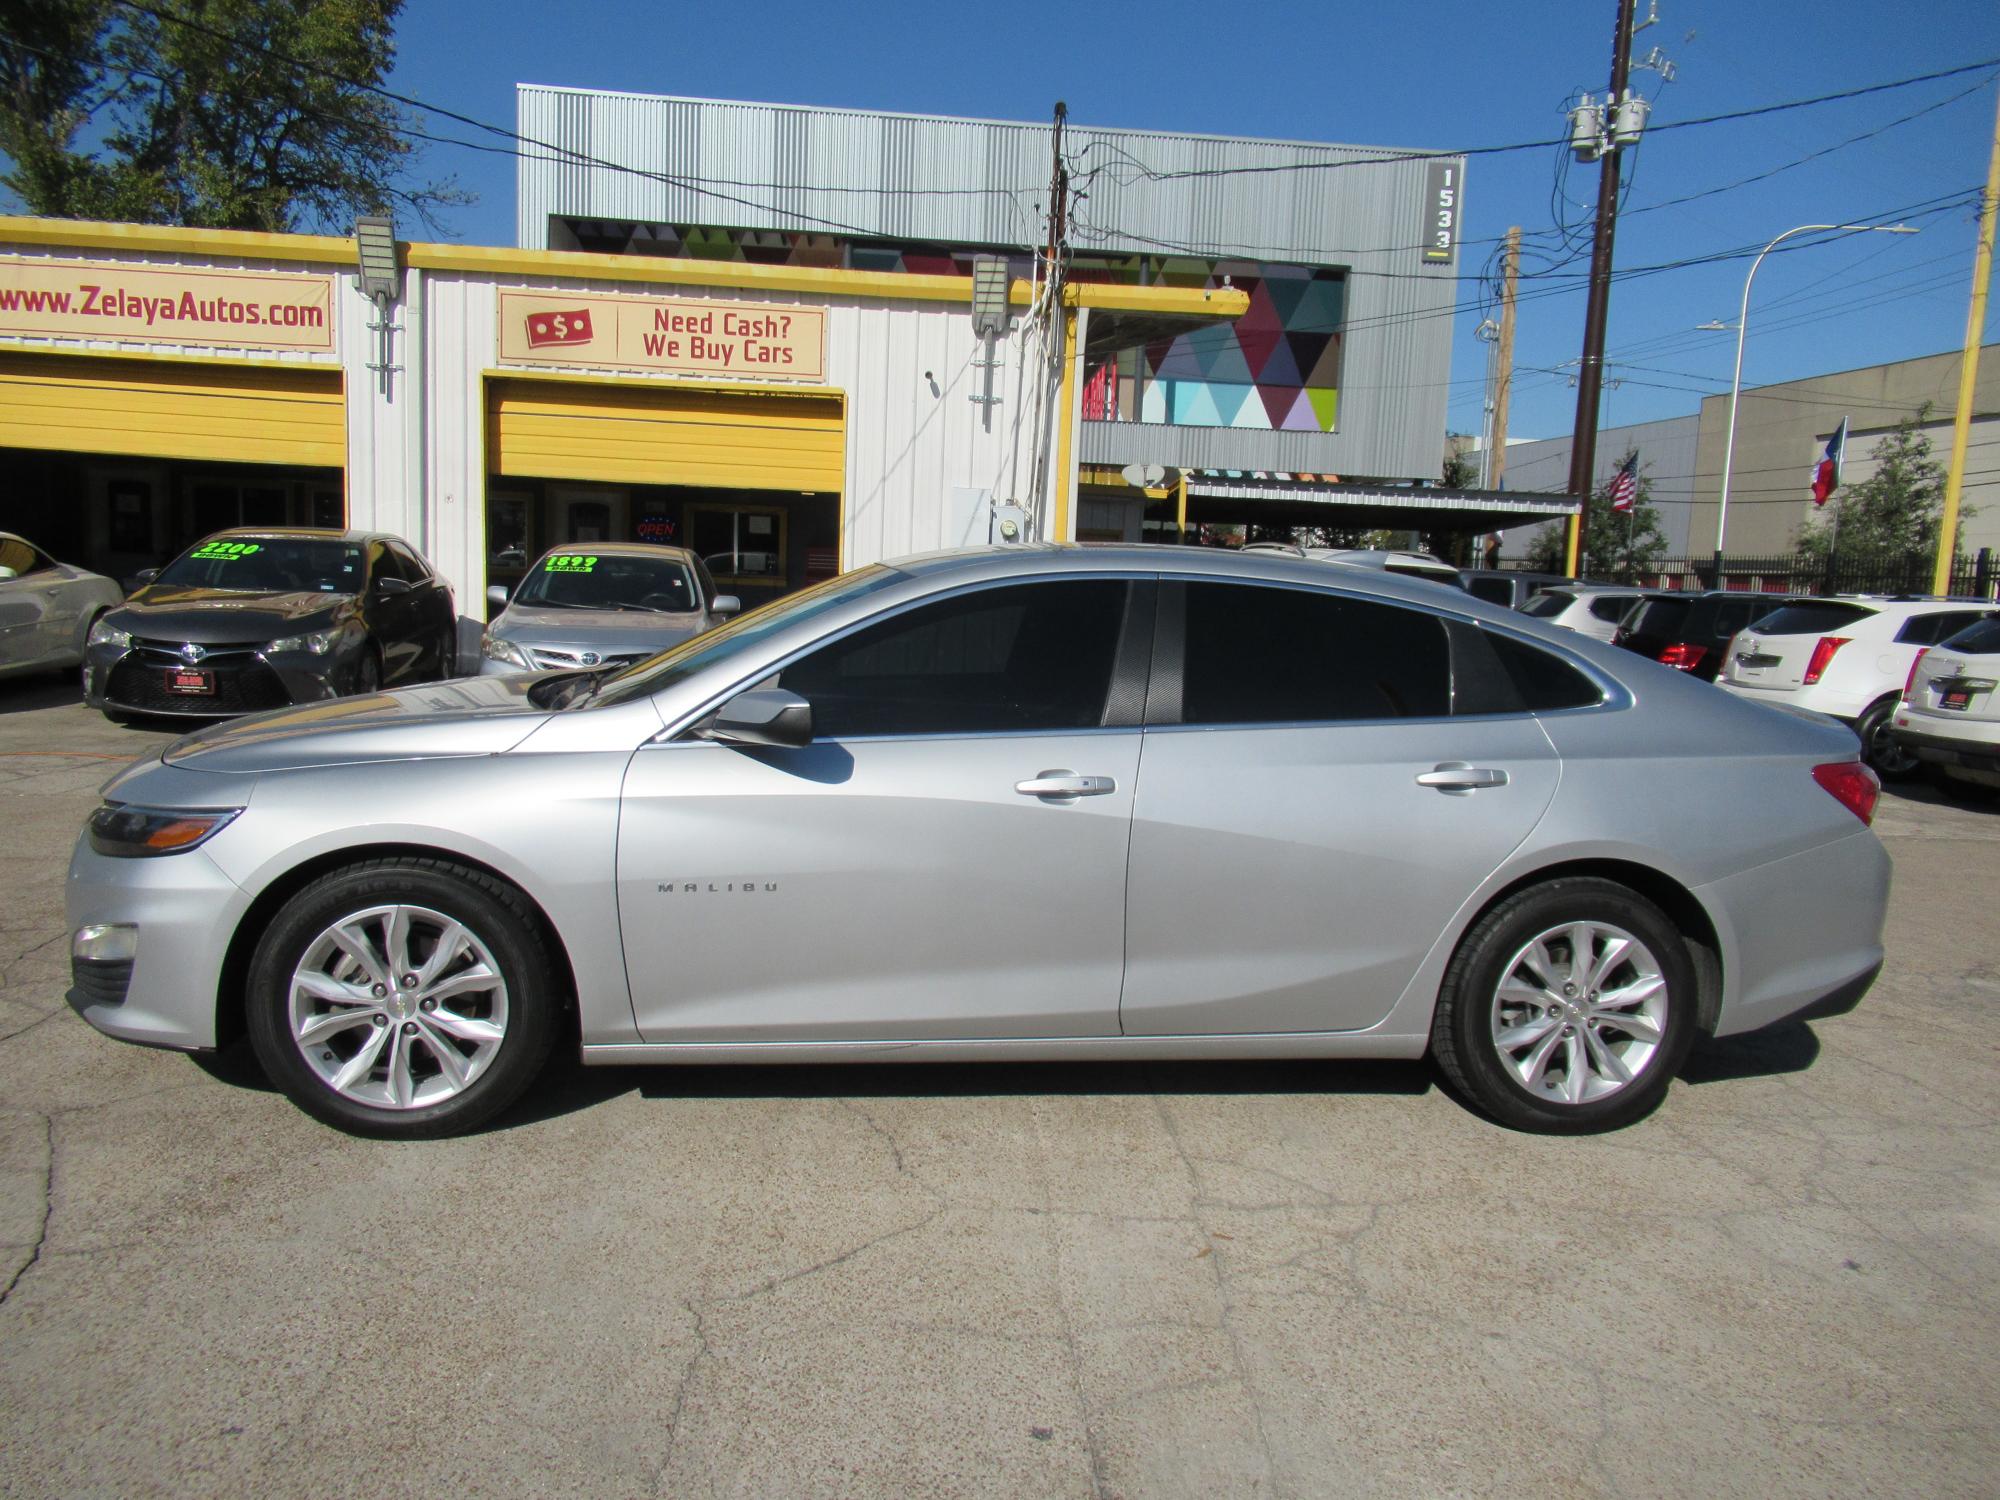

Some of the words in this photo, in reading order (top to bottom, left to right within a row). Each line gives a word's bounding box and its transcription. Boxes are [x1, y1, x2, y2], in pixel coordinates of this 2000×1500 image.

[1436, 169, 1453, 248] 1533
[0, 285, 323, 327] www.ZelayaAutos.com
[654, 308, 713, 335] Need
[723, 312, 792, 339] Cash?
[643, 333, 680, 358] We
[690, 336, 734, 366] Buy
[744, 339, 793, 364] Cars
[637, 523, 674, 536] OPEN
[200, 542, 260, 555] 2200
[546, 556, 598, 567] 1899
[657, 883, 777, 892] MALIBU
